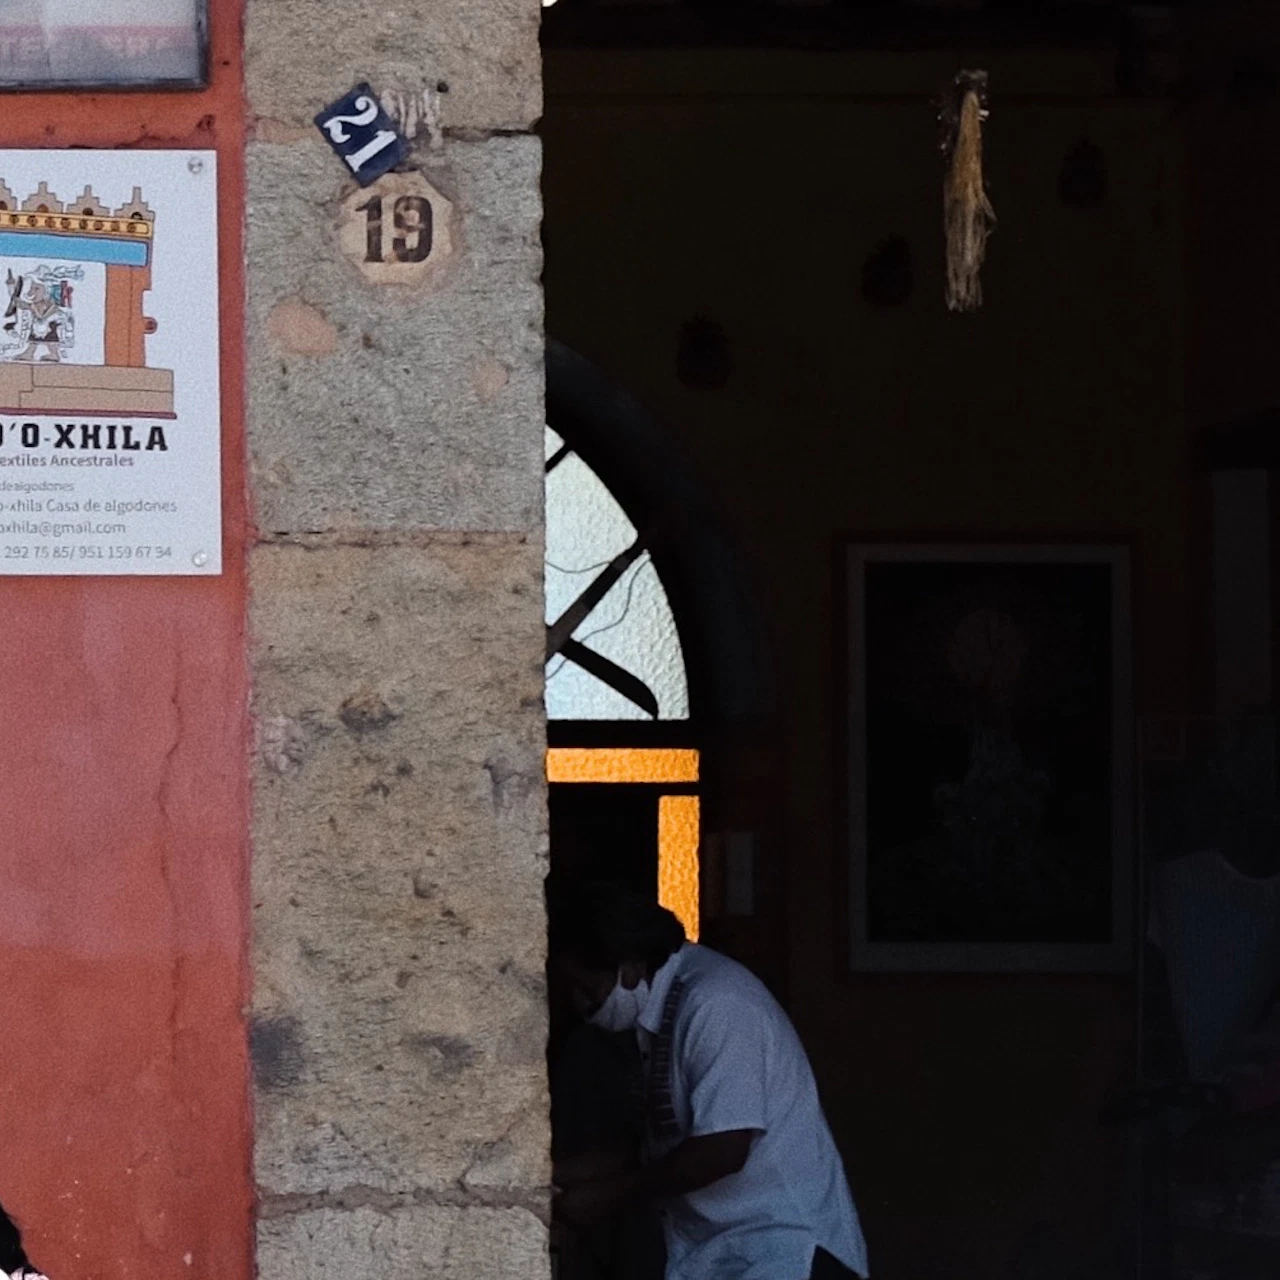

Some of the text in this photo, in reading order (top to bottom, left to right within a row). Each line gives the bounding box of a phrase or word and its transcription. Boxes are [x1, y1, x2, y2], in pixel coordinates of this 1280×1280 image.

[323, 96, 397, 173] 21
[355, 195, 433, 263] 19
[50, 454, 134, 467] Ancestrales
[46, 499, 79, 512] Casa
[83, 499, 100, 512] de
[104, 499, 177, 516] algodones
[4, 546, 28, 559] 292
